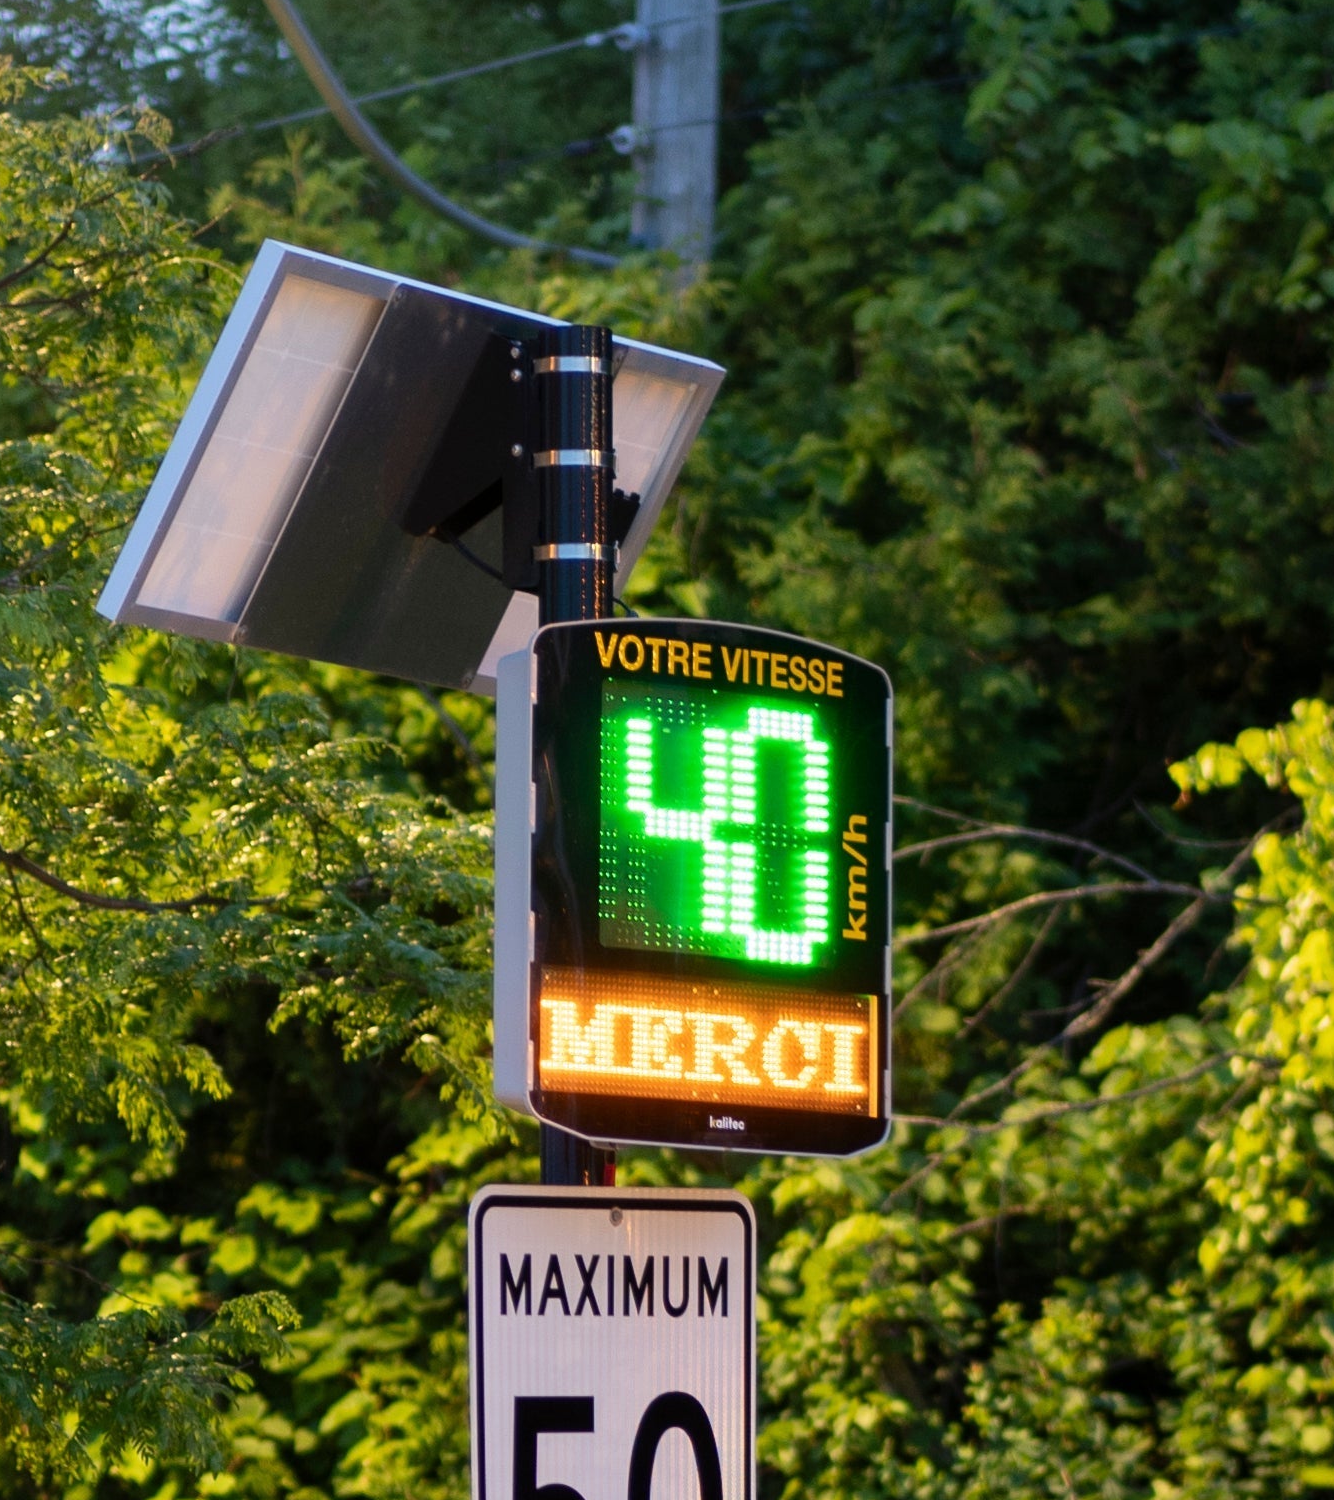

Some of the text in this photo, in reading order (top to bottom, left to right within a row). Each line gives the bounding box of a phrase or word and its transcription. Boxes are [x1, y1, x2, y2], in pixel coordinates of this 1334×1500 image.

[594, 632, 844, 697] VOTRE VITESSE
[625, 707, 830, 964] 40
[842, 814, 867, 941] km/h
[540, 998, 864, 1093] MERCI
[709, 1115, 745, 1130] kalitec
[499, 1253, 729, 1318] MAXIMUM
